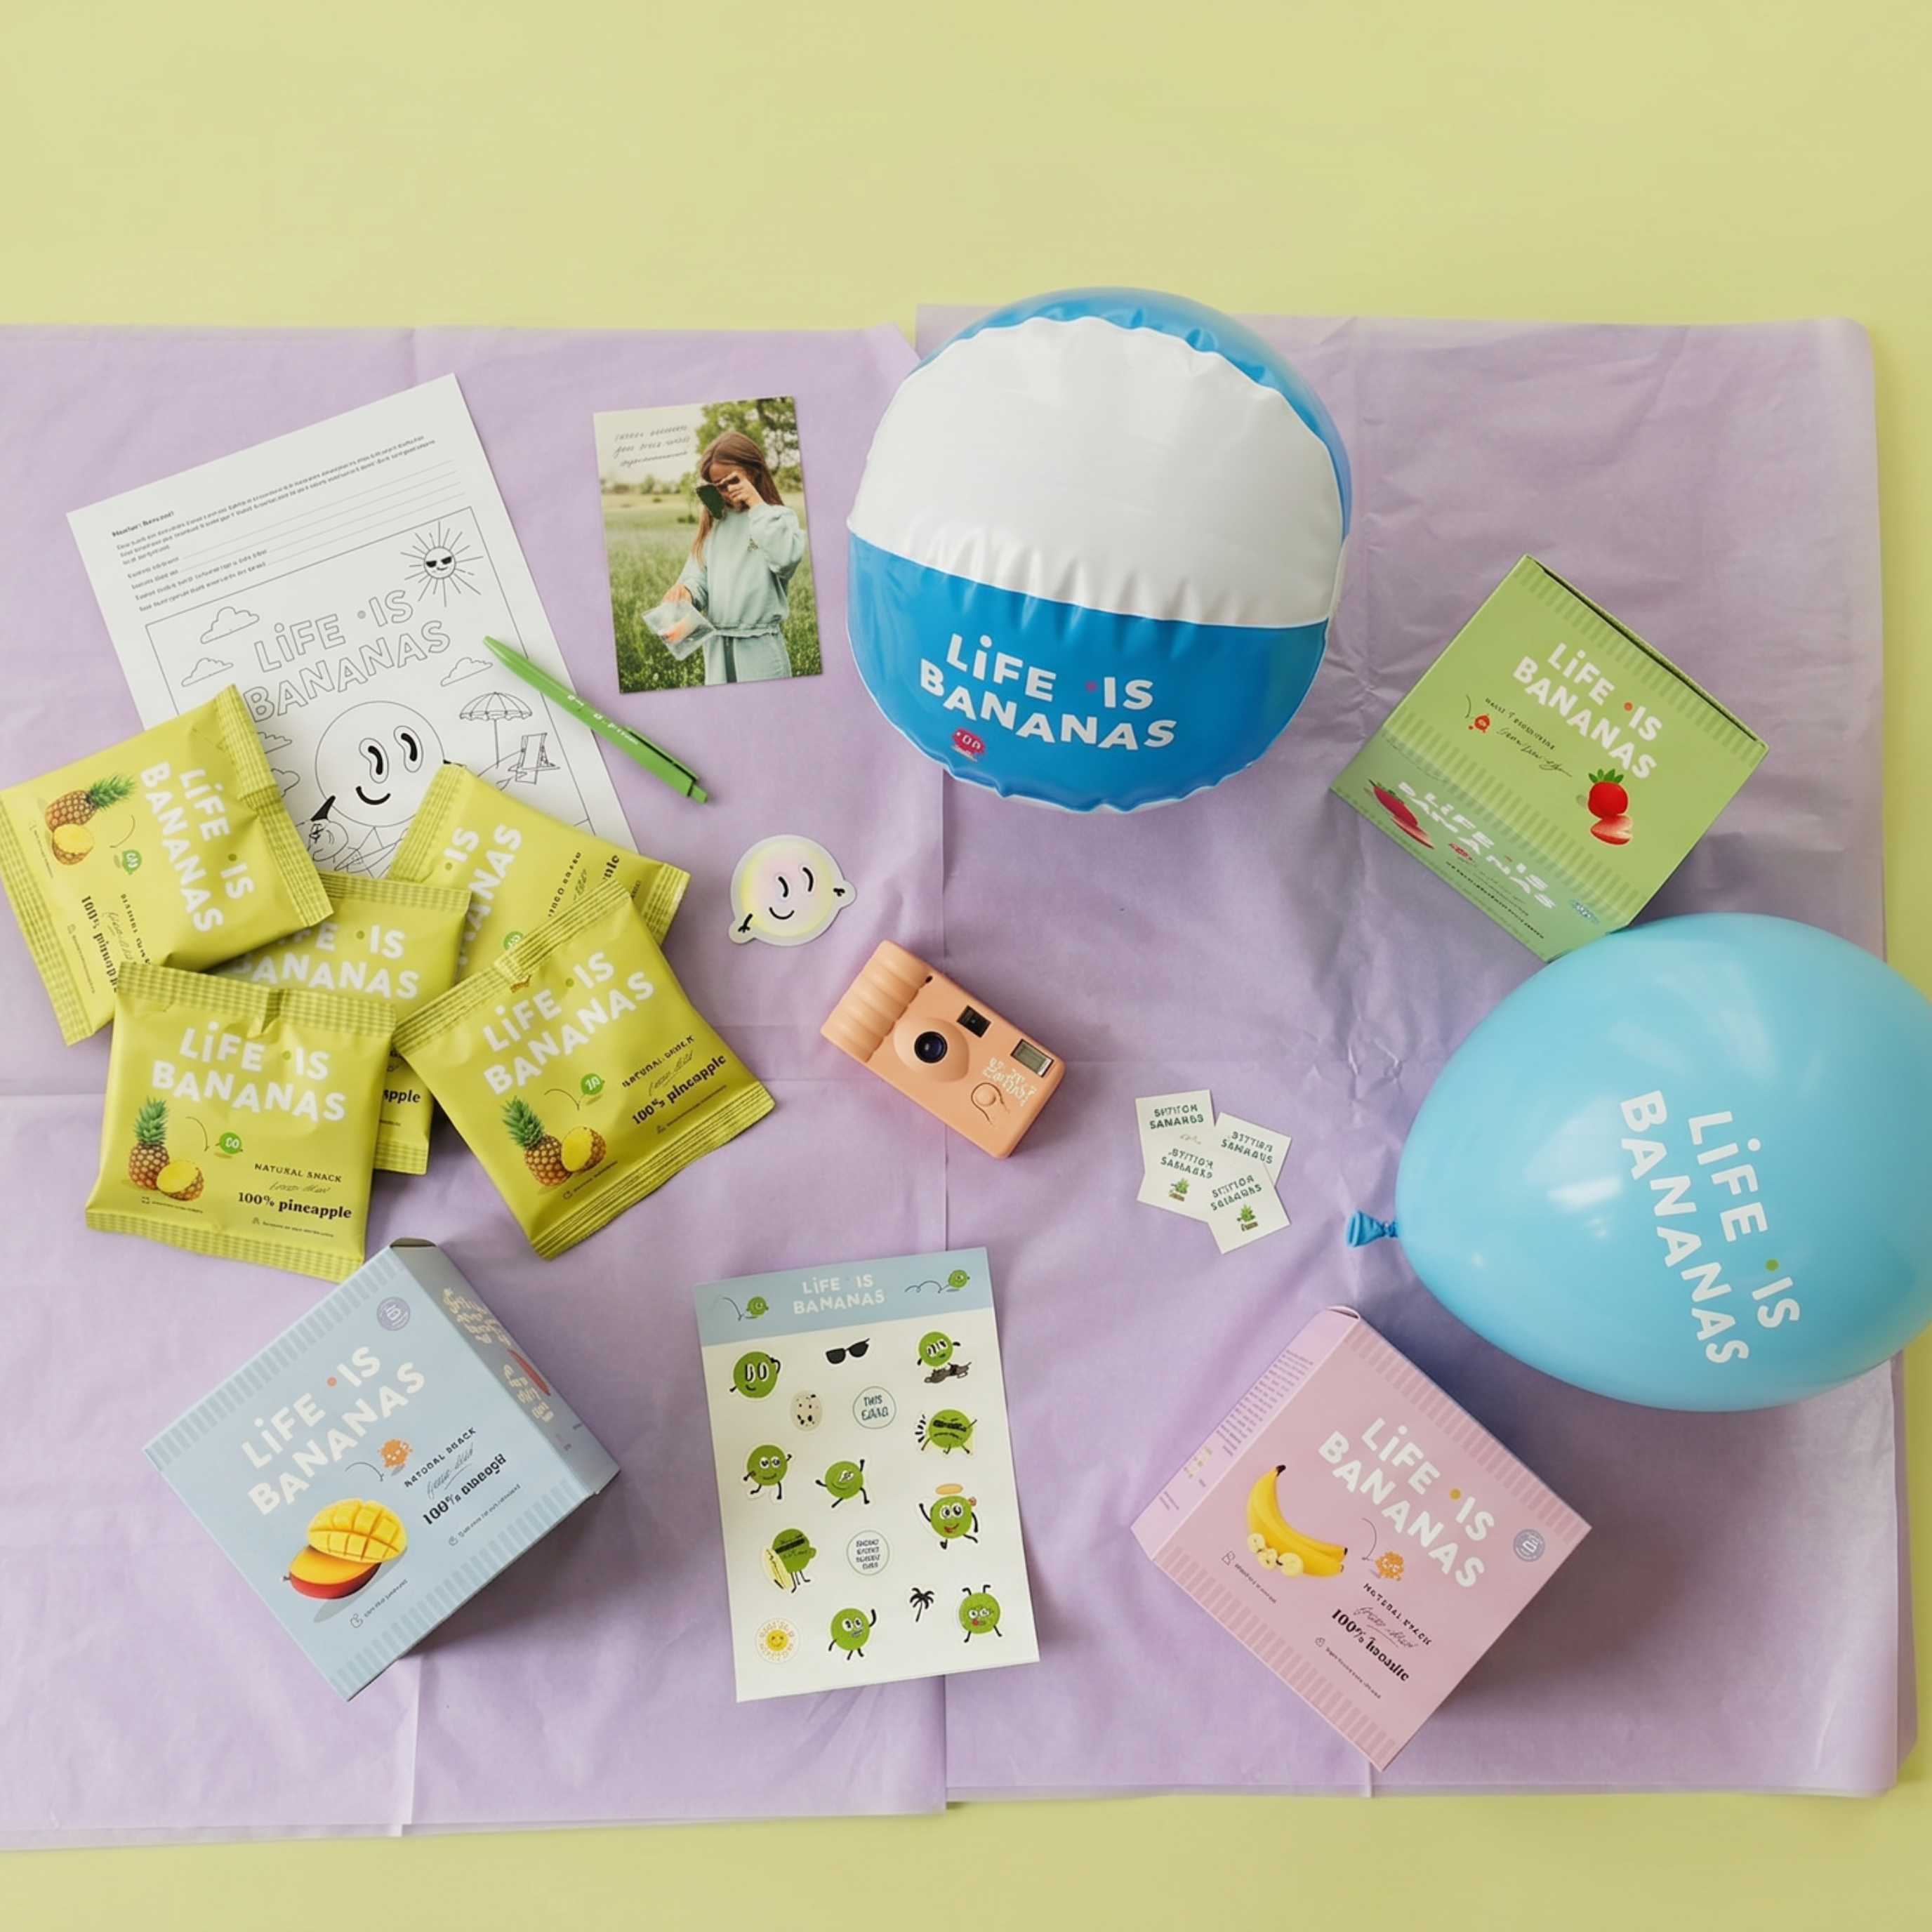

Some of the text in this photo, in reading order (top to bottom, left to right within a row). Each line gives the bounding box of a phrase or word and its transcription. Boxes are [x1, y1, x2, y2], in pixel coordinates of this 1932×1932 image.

[369, 590, 413, 627] IS
[243, 620, 451, 722] BANANAS
[920, 658, 1177, 750] BANANAS
[946, 633, 1153, 710] LiFE IS
[1547, 642, 1662, 741] LiFE IS
[1512, 656, 1658, 779] BANANAS
[140, 762, 224, 932] BANANAS
[443, 828, 479, 862] IS
[220, 863, 254, 899] IS
[369, 925, 406, 960] IS
[573, 952, 614, 989] IS
[296, 1045, 329, 1080] IS
[483, 972, 654, 1095] BANANAS
[152, 1060, 346, 1122] BANANAS
[238, 1192, 352, 1219] 100% pineapple
[1620, 1090, 1750, 1364] BANANAS
[1688, 1111, 1800, 1328] LiFE IS
[793, 1289, 886, 1315] BANANAS
[856, 1273, 874, 1288] IS
[336, 1347, 381, 1388] IS
[247, 1362, 425, 1516] BANANAS
[1318, 1431, 1486, 1588] BANANAS
[1361, 1417, 1495, 1542] LiFE IS
[1332, 1608, 1365, 1644] 100%
